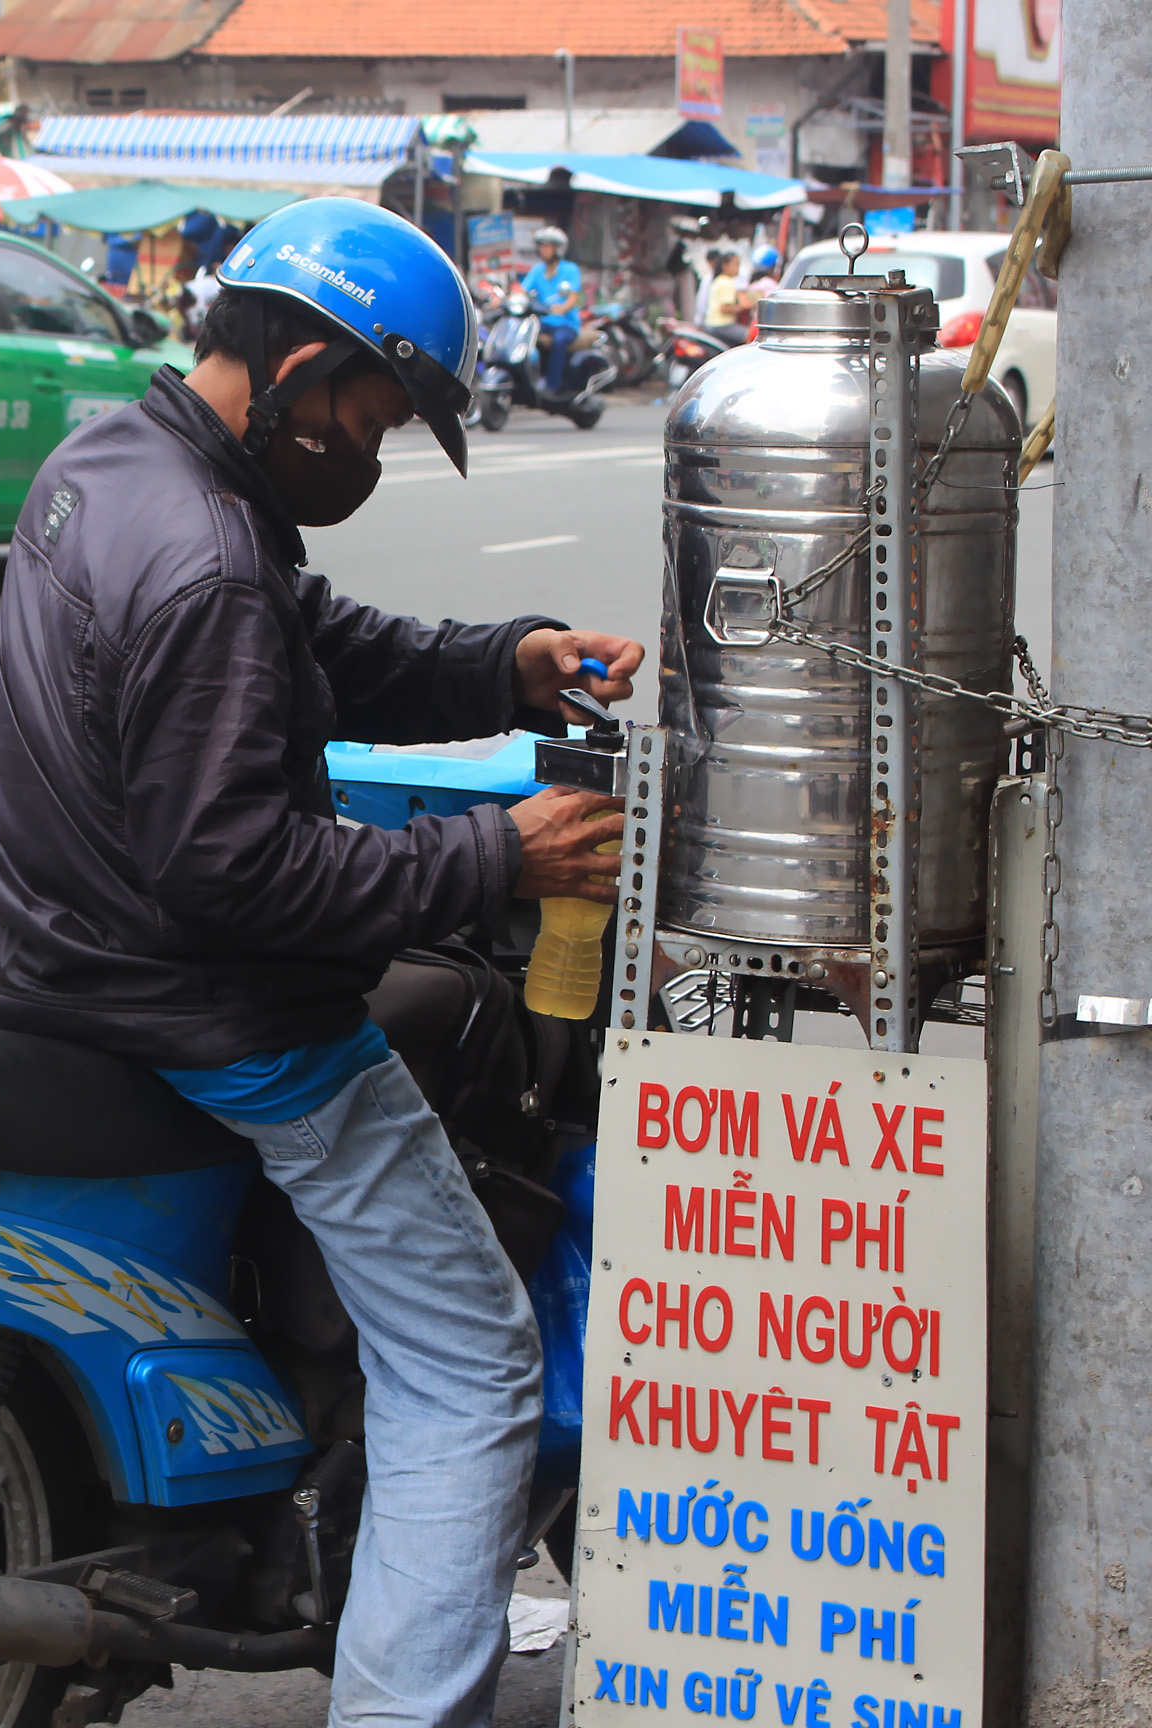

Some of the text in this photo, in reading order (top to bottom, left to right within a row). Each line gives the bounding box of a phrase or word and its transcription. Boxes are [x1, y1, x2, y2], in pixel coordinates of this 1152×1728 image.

[276, 244, 376, 306] Sacombank
[637, 1081, 945, 1177] BƠM VÁ XE
[664, 1170, 911, 1273] MIỄN PHÍ
[619, 1277, 940, 1377] CHO NGƯỜI
[865, 1401, 961, 1493] TẬT
[616, 1479, 945, 1578] NƯỚC UỐNG
[648, 1563, 921, 1664] MIỄN PHÍ
[594, 1659, 668, 1709] XIN
[683, 1667, 763, 1721] GIỮ
